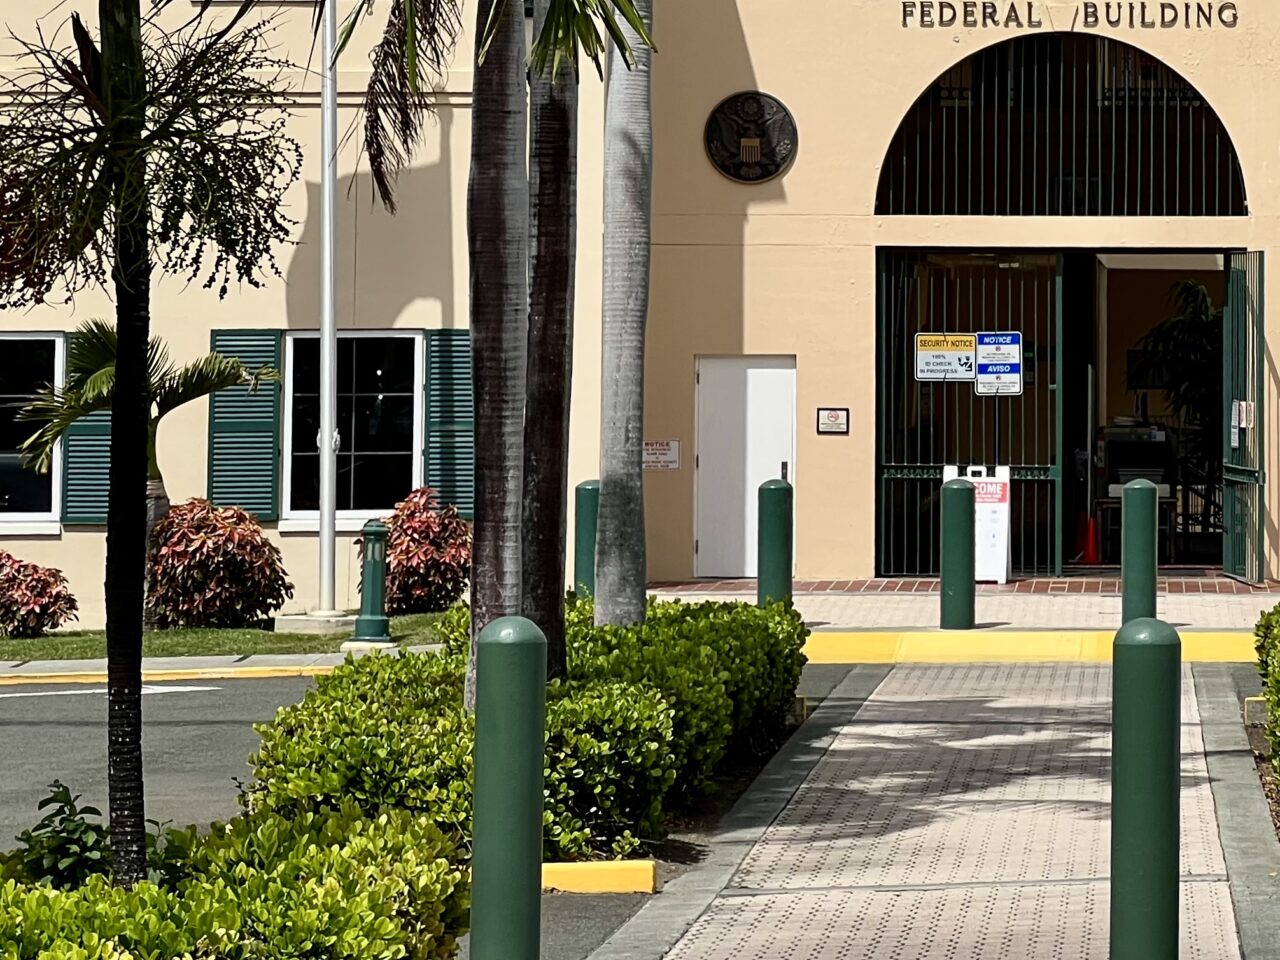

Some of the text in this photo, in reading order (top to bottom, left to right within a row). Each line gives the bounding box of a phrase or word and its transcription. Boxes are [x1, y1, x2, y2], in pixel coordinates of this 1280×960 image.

[902, 1, 1239, 28] FEDERAL BUILDING
[919, 339, 974, 348] SECURITY NOTICE
[983, 336, 1012, 344] NOTICE
[987, 365, 1011, 373] AVISO
[973, 483, 1003, 495] COME
